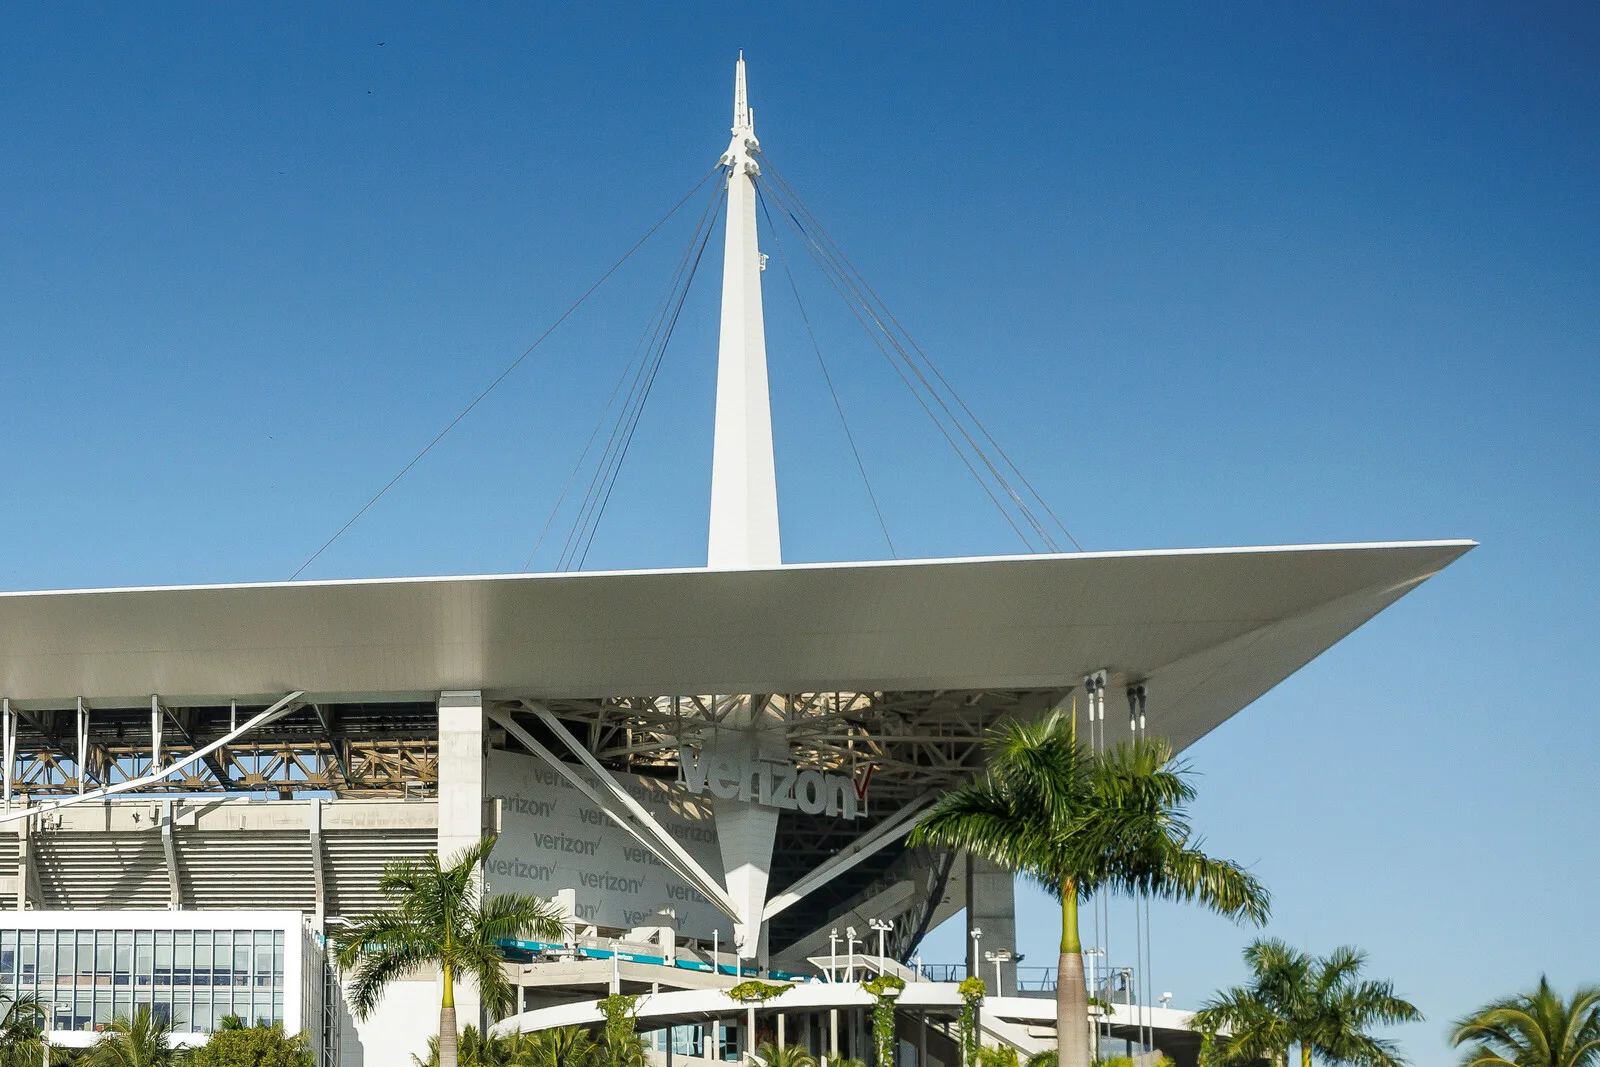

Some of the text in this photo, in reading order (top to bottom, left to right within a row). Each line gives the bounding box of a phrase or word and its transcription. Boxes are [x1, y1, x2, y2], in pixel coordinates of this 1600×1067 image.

[680, 745, 858, 820] verizon
[488, 793, 550, 817] erizon
[533, 832, 595, 856] verizon
[488, 858, 551, 882] verizon
[580, 871, 639, 894] verizon
